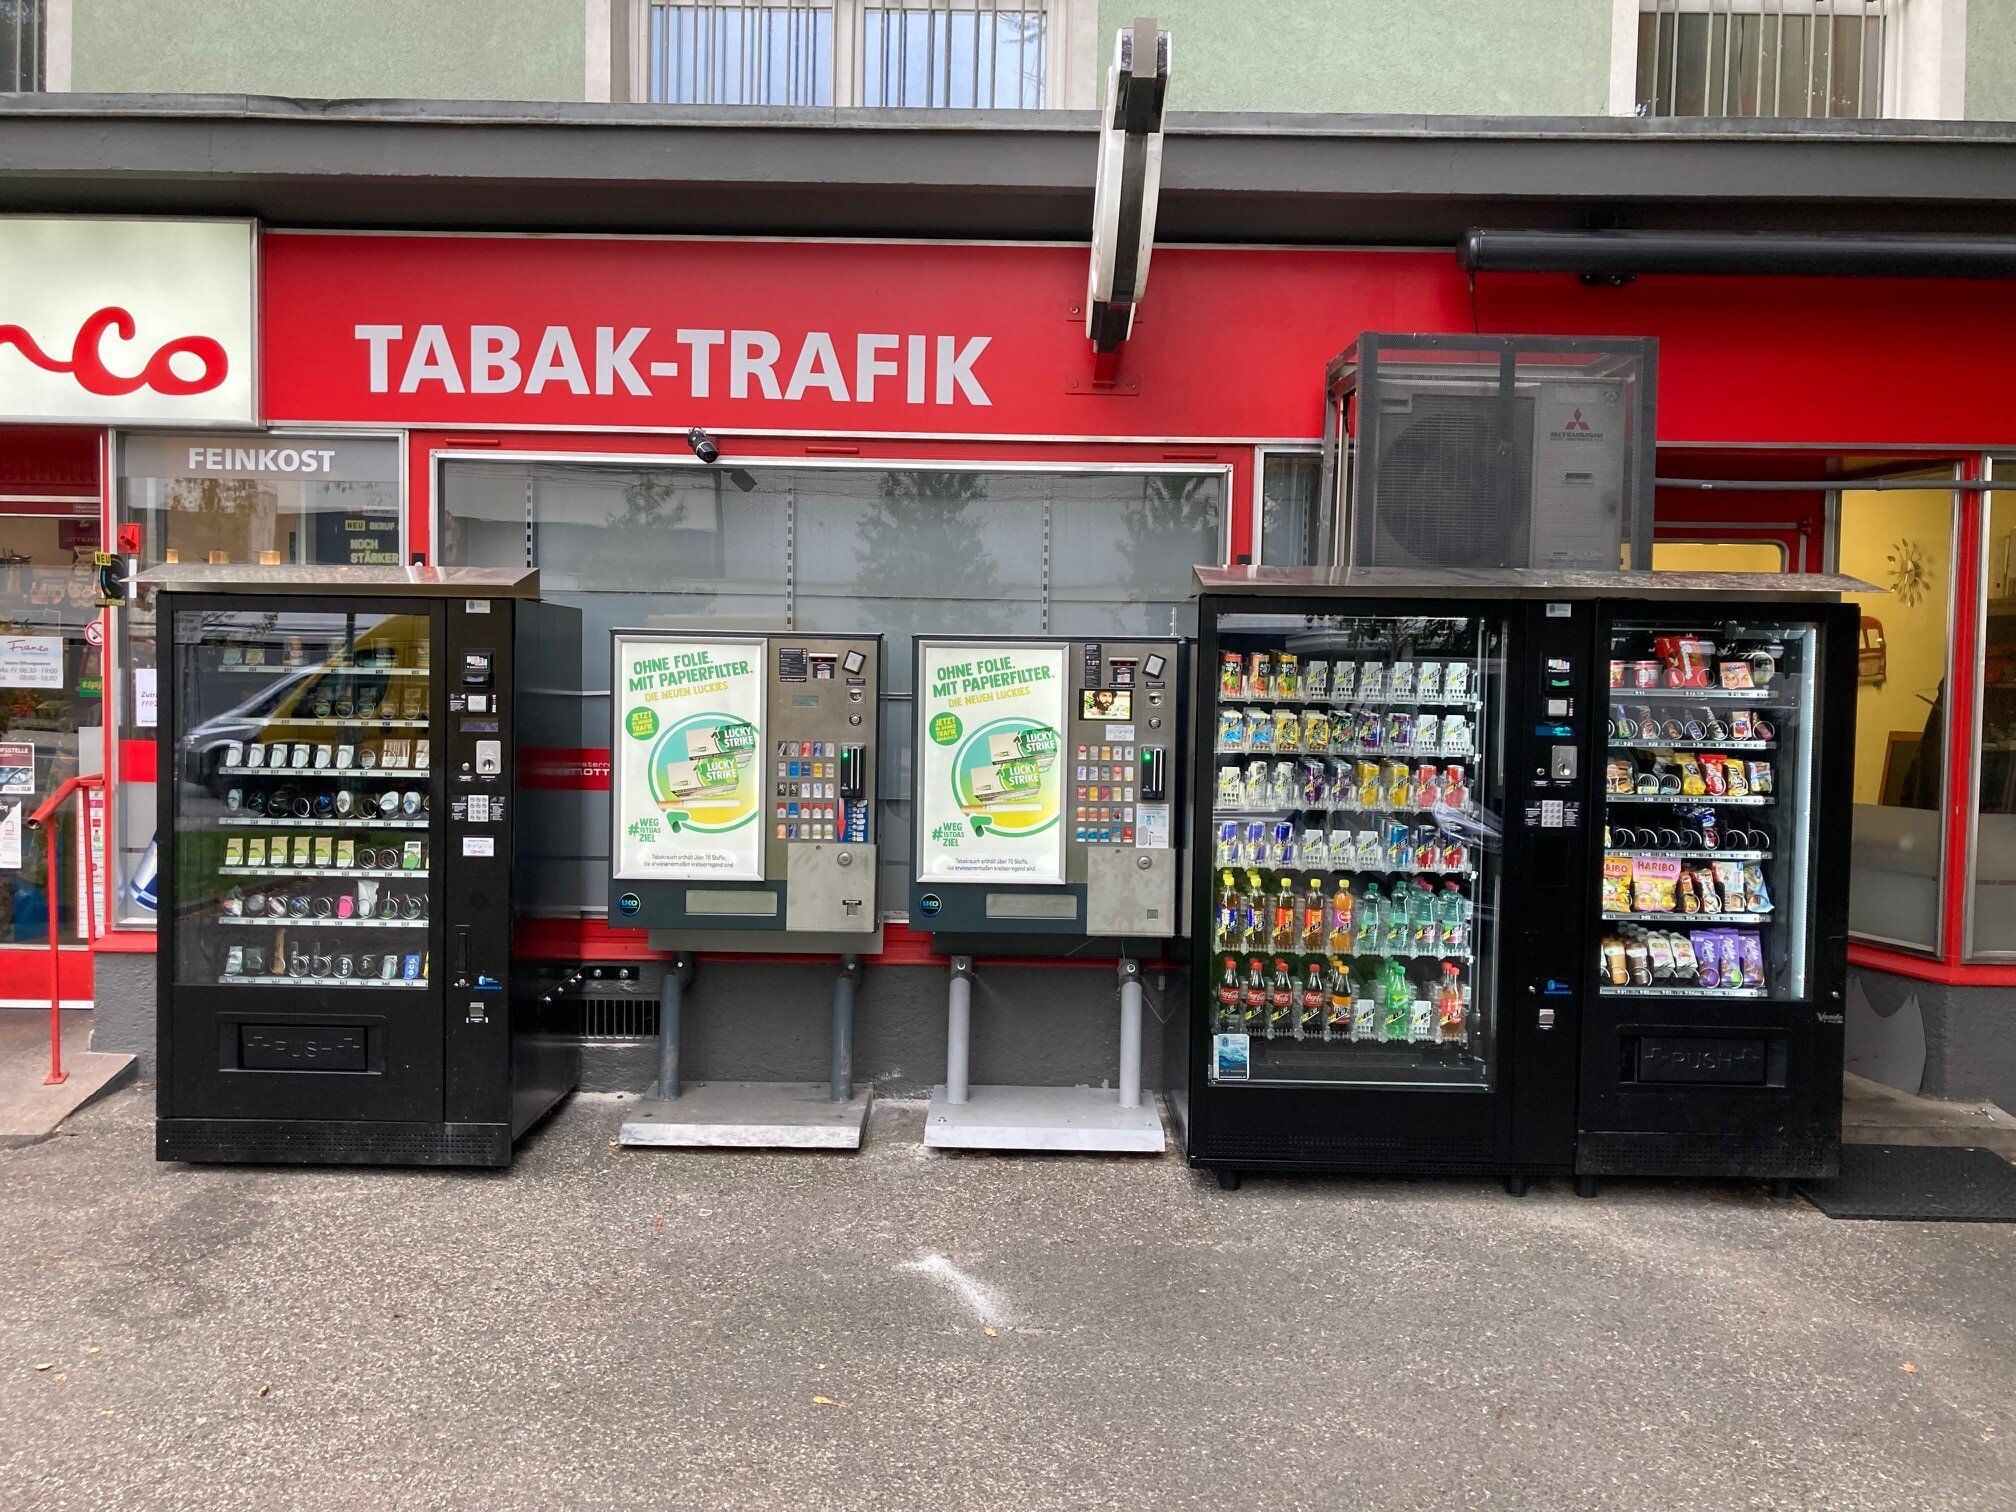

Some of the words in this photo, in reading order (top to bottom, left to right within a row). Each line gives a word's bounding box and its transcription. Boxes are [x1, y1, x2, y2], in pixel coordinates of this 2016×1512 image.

[355, 324, 993, 406] TABAK-TRAFIK
[189, 447, 336, 472] FEINKOST
[350, 538, 379, 550] NOCH
[96, 553, 111, 565] NEU
[633, 656, 670, 676] OHNE
[674, 650, 713, 667] FOLIE.
[936, 662, 973, 682] OHNE
[977, 656, 1015, 675] FOLIE.
[628, 676, 657, 692] MIT
[659, 660, 754, 684] PAPIERFILTER.
[932, 681, 961, 698] MIT
[962, 665, 1055, 690] PAPIERFILTER.
[644, 692, 659, 702] DIE
[662, 687, 691, 700] NEUEN
[694, 681, 728, 695] LUCKIES
[948, 697, 962, 708] DIE
[965, 692, 994, 705] NEUEN
[996, 686, 1030, 700] LUCKIES
[724, 725, 752, 738] LUCKY
[1026, 730, 1052, 743] LUCKY
[724, 736, 754, 748] STRIKE
[1025, 740, 1056, 752] STRIKE
[706, 759, 735, 771] LUCKY
[1009, 764, 1037, 776] LUCKY
[706, 768, 738, 781] STRIKE
[1009, 773, 1039, 786] STRIKE
[638, 834, 656, 842] ZIEL
[942, 838, 959, 847] ZIEL
[1605, 864, 1628, 872] RIBO
[1637, 861, 1675, 872] HARIBO
